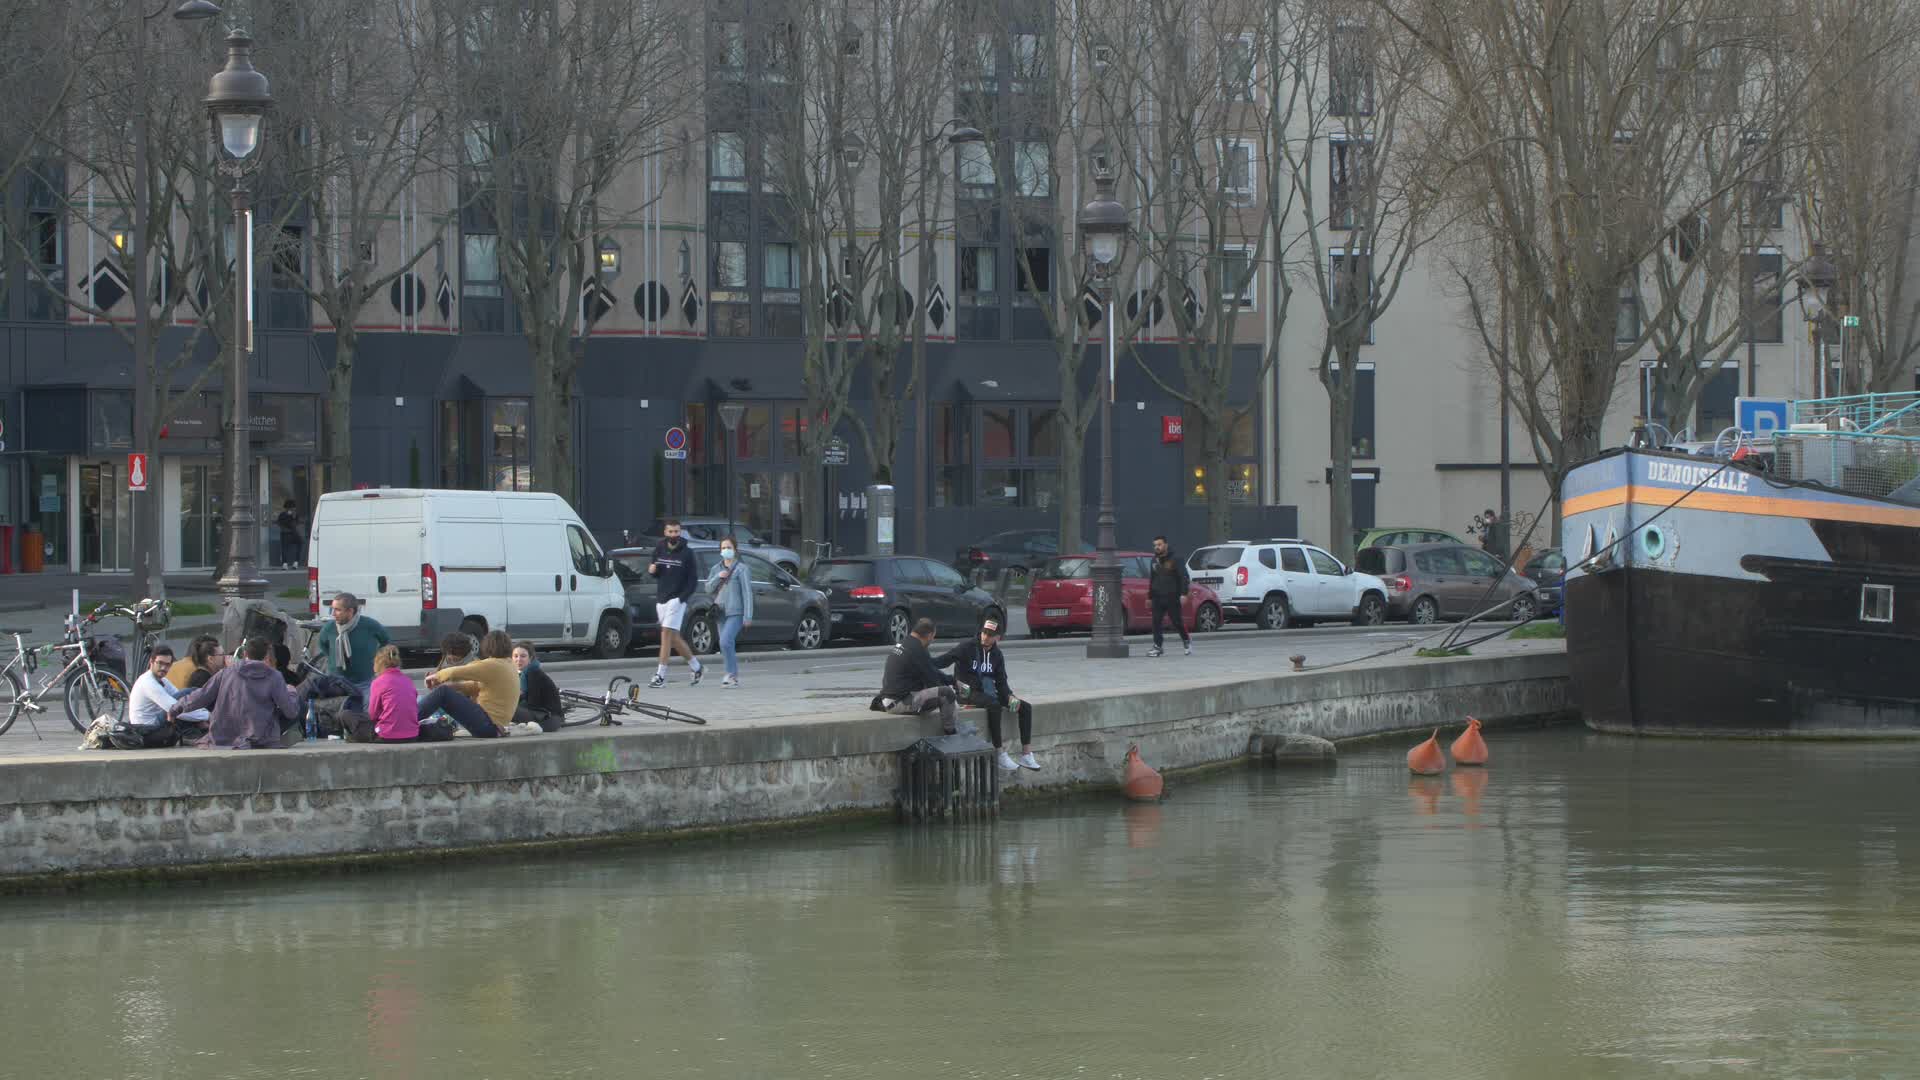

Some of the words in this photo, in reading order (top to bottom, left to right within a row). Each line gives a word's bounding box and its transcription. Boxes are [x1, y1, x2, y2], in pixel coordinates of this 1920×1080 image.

[1168, 422, 1182, 434] ibis
[1648, 460, 1749, 493] DEMOISELLE
[972, 660, 993, 673] DOR
